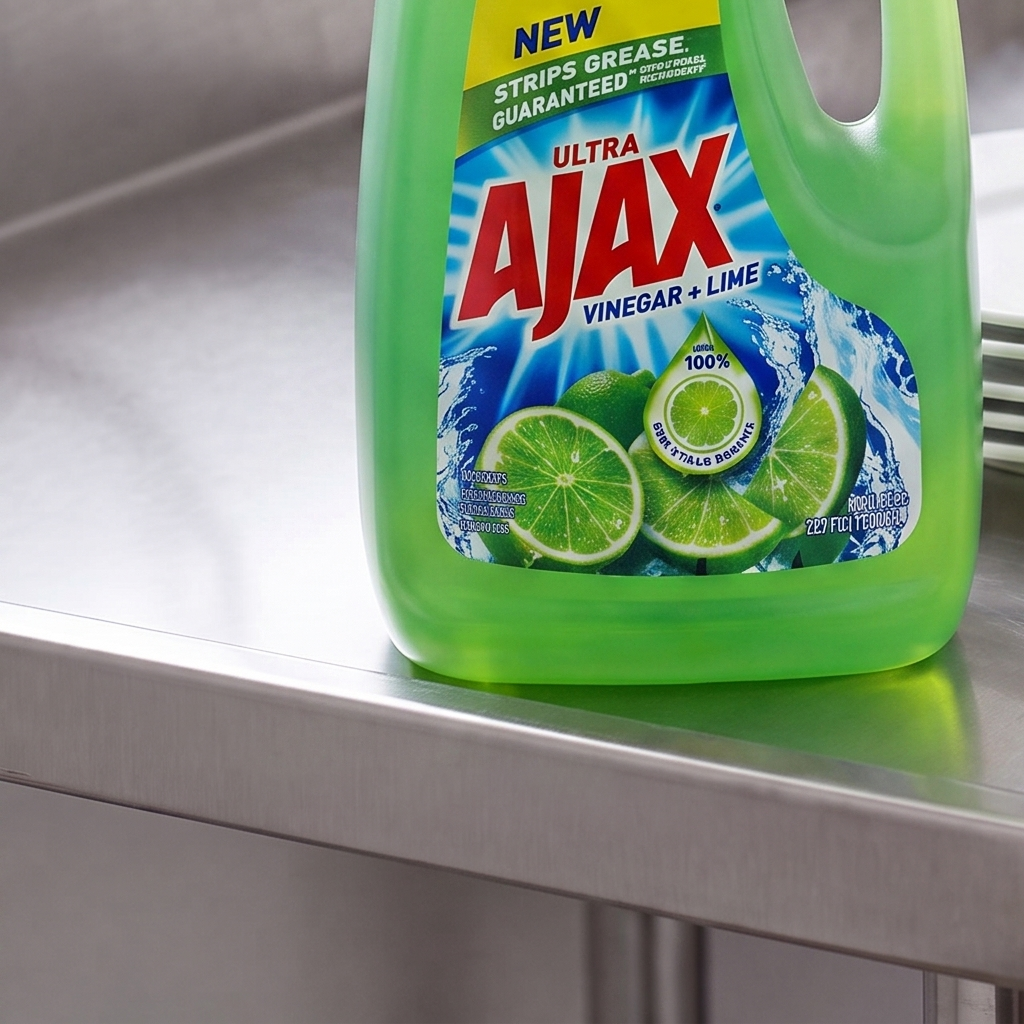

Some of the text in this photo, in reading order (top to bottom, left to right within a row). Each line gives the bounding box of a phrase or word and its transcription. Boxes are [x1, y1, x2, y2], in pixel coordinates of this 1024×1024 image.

[514, 6, 602, 60] NEW
[494, 60, 577, 104] STRIPS
[553, 133, 639, 168] ULTRA
[457, 132, 734, 342] AJAX
[583, 285, 682, 325] VINEGAR
[706, 261, 760, 297] LIME
[684, 353, 730, 370] 100%
